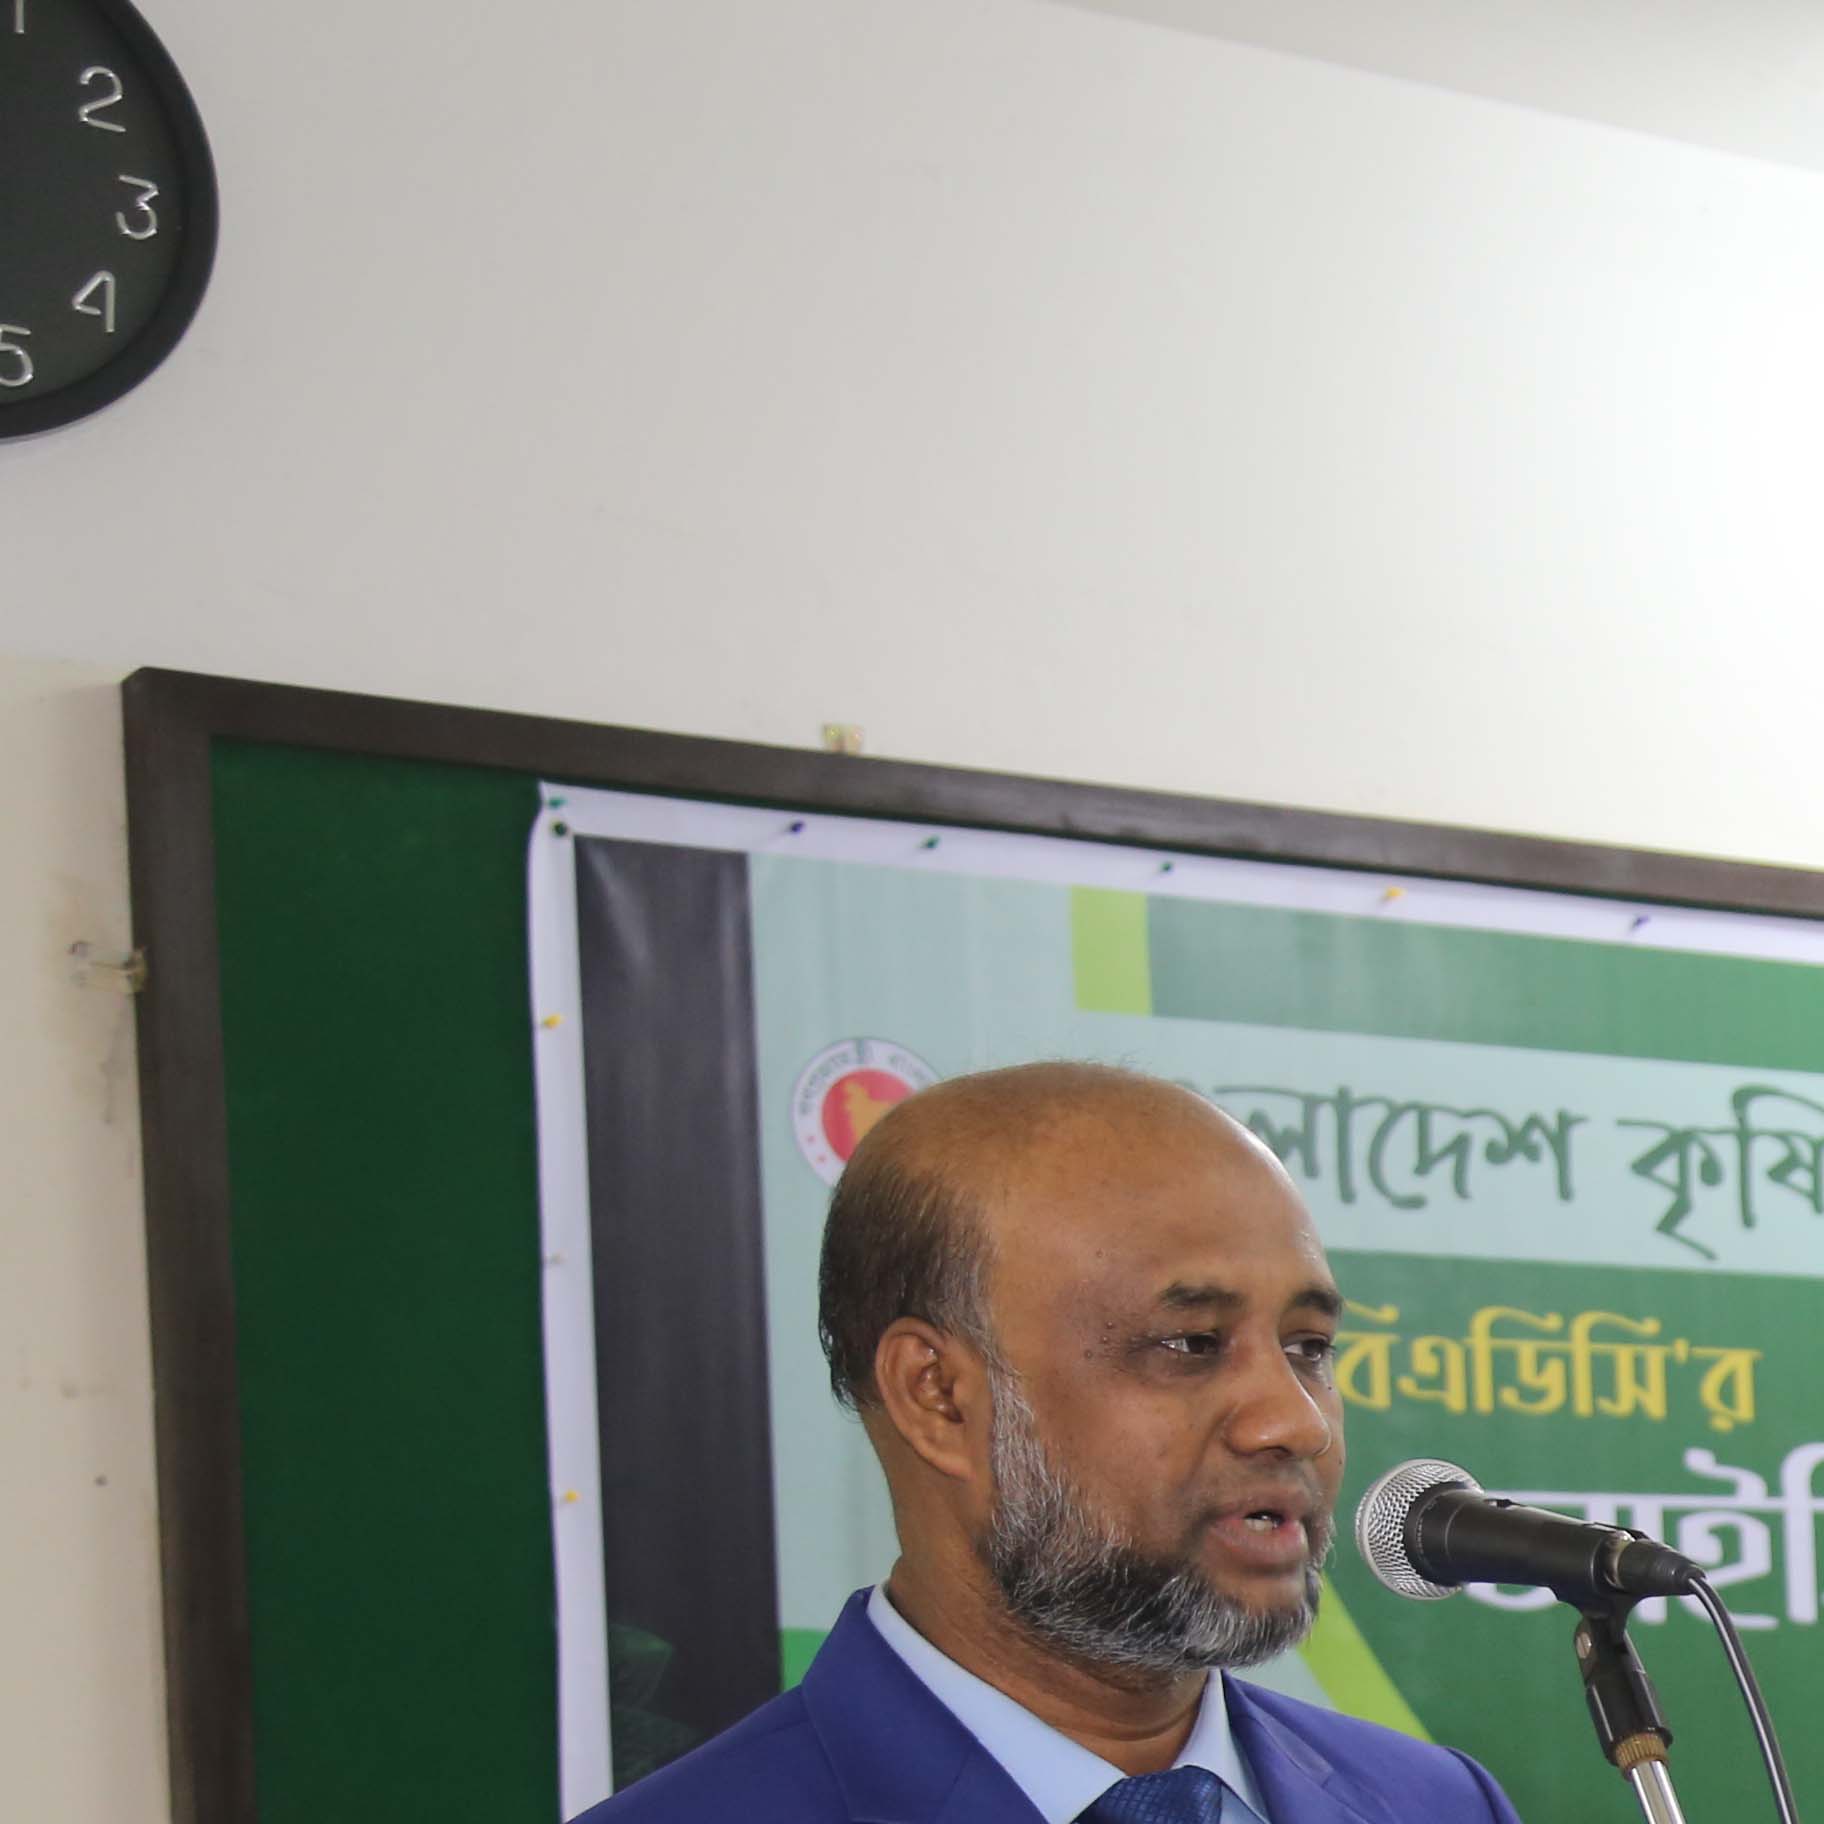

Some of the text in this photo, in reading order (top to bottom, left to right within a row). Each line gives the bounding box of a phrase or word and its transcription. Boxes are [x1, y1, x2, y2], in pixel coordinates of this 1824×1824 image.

[79, 65, 126, 133] 2
[115, 174, 159, 240] 3
[71, 270, 115, 333] 4
[1213, 1085, 1588, 1210] লাদেশ
